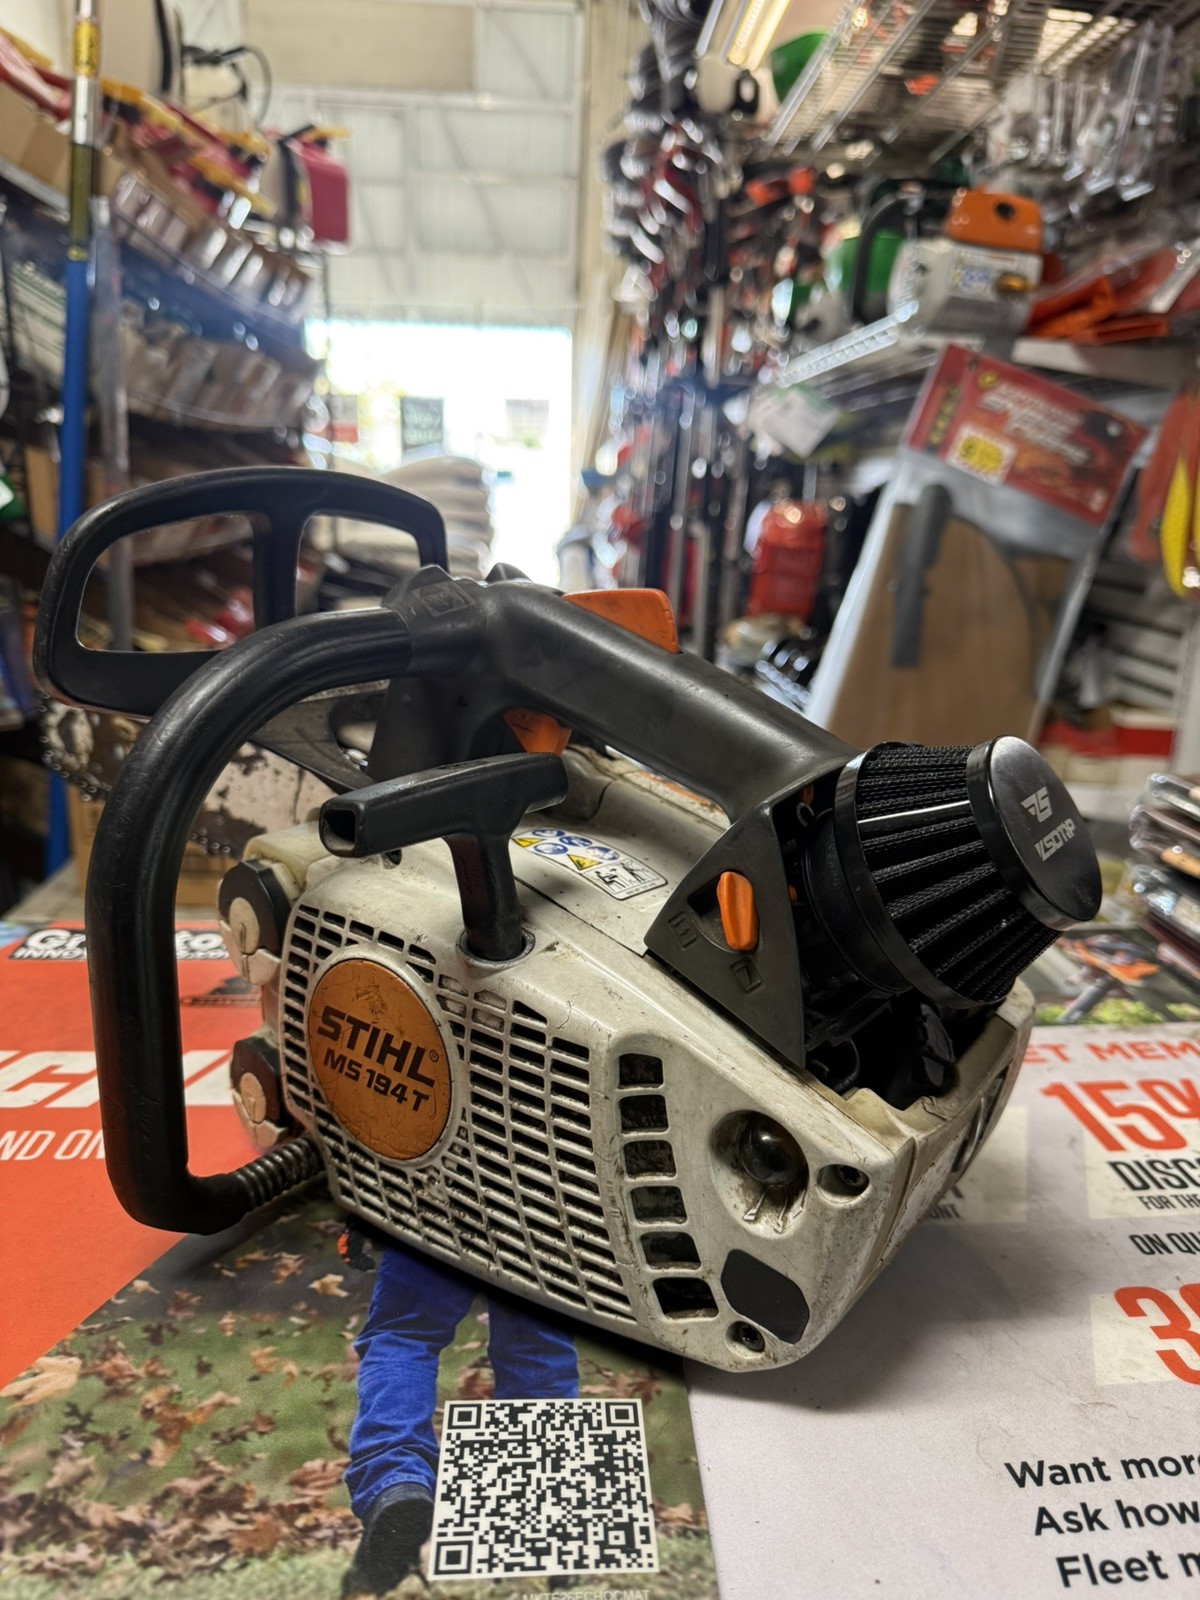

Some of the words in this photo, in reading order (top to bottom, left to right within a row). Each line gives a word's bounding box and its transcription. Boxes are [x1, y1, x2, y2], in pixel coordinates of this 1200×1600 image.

[1083, 1040, 1200, 1062] MEM
[1105, 1158, 1200, 1191] DISC
[1137, 1194, 1177, 1211] FOR
[1128, 1232, 1174, 1256] ON
[1113, 1282, 1200, 1386] 3
[1004, 1456, 1112, 1489] Want
[1119, 1453, 1200, 1480] mor
[1034, 1501, 1110, 1537] Ask
[1115, 1498, 1200, 1530] how
[1055, 1550, 1169, 1589] Fleet
